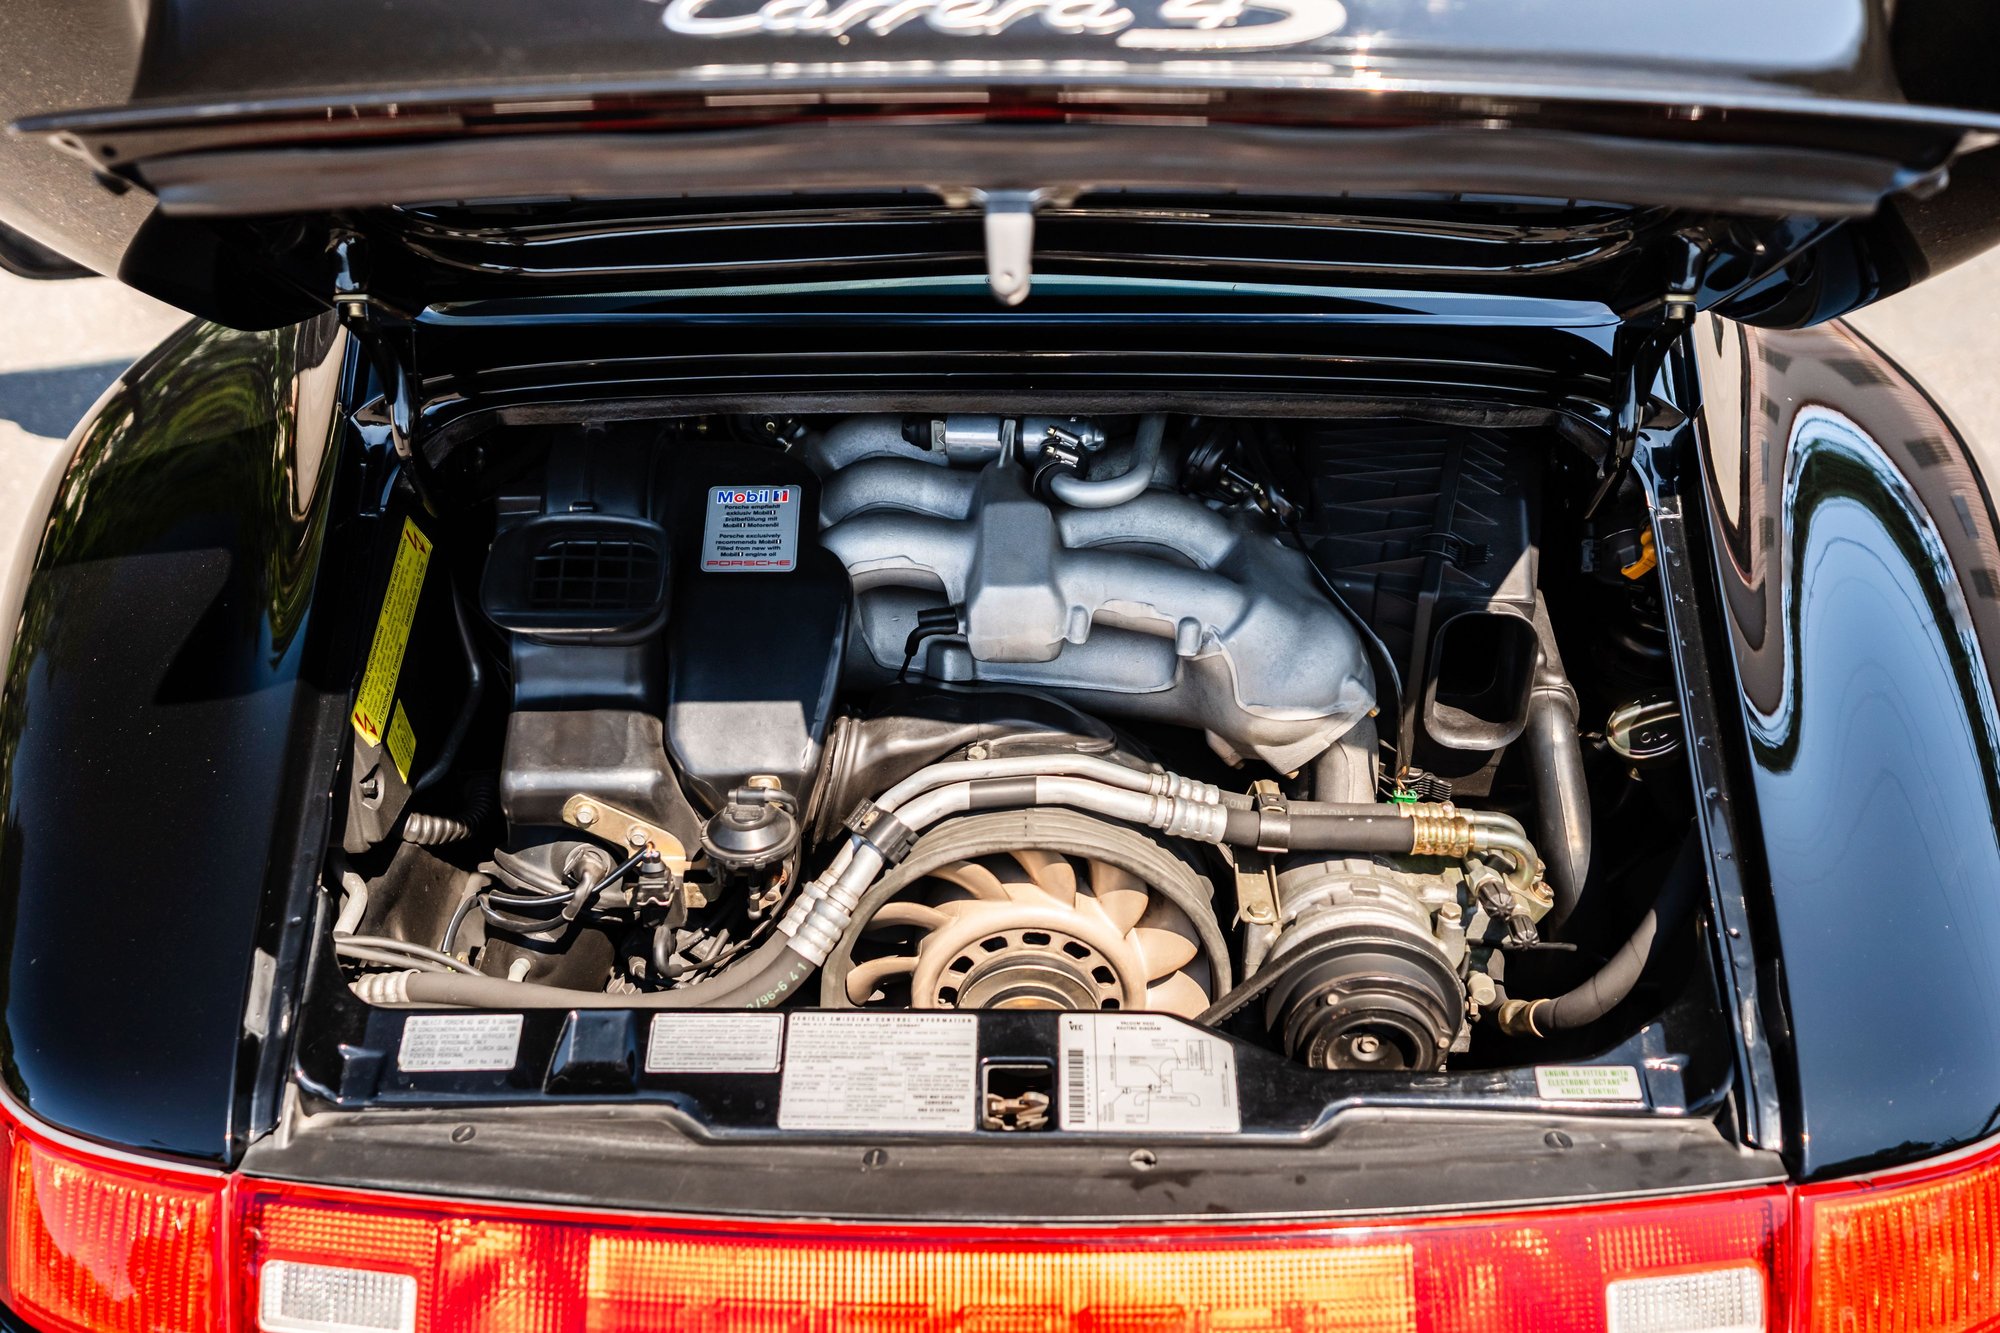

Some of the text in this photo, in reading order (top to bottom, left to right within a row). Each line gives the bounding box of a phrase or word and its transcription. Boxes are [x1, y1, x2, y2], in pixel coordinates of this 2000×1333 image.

[662, 0, 1135, 36] Carrera
[717, 489, 770, 504] Mobil
[360, 675, 371, 704] ACHTUNG
[1544, 1069, 1629, 1077] ENGINE IS FITTED WITH
